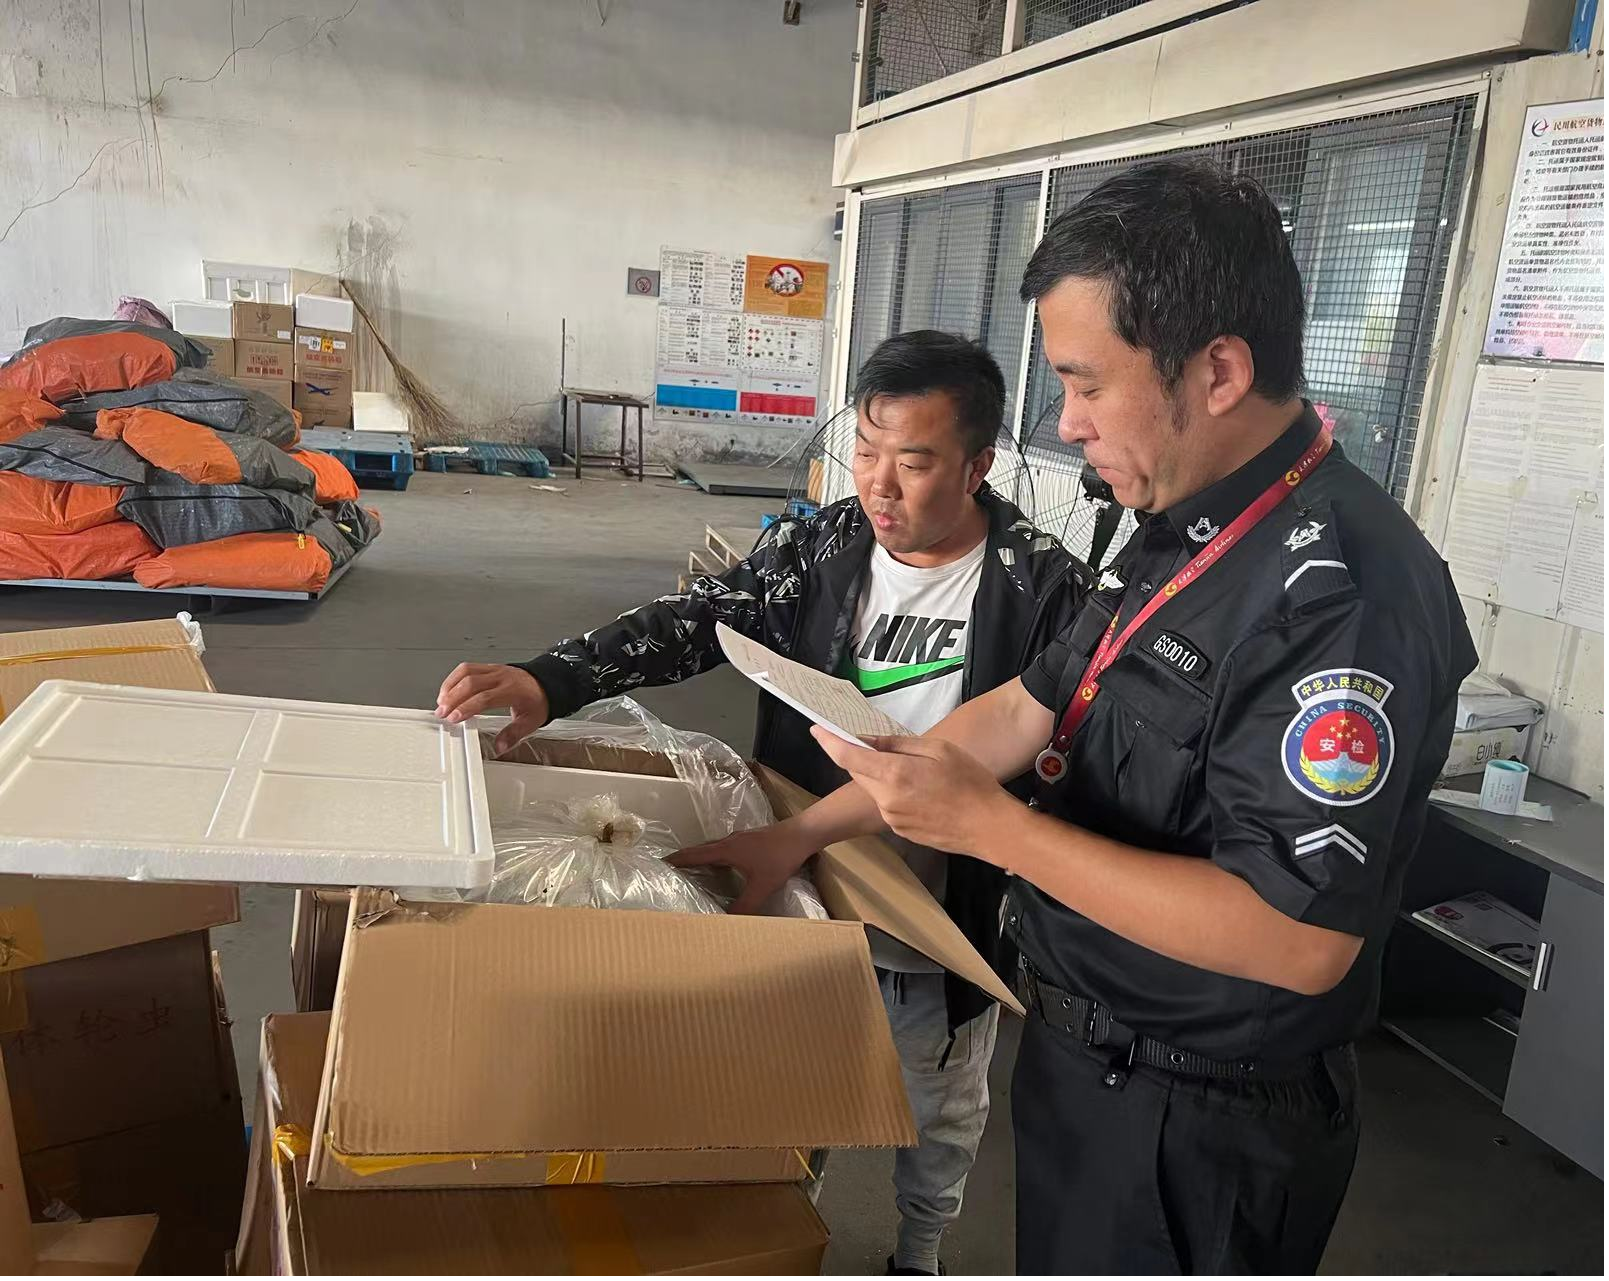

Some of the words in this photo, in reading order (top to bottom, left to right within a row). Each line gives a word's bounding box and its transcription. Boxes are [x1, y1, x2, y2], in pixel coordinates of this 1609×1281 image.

[858, 613, 967, 664] NIKE
[1153, 634, 1198, 672] GS0010
[1301, 676, 1385, 701] 中华人民共和国
[1295, 705, 1328, 737] CHINA
[1337, 702, 1385, 745] SECURITY
